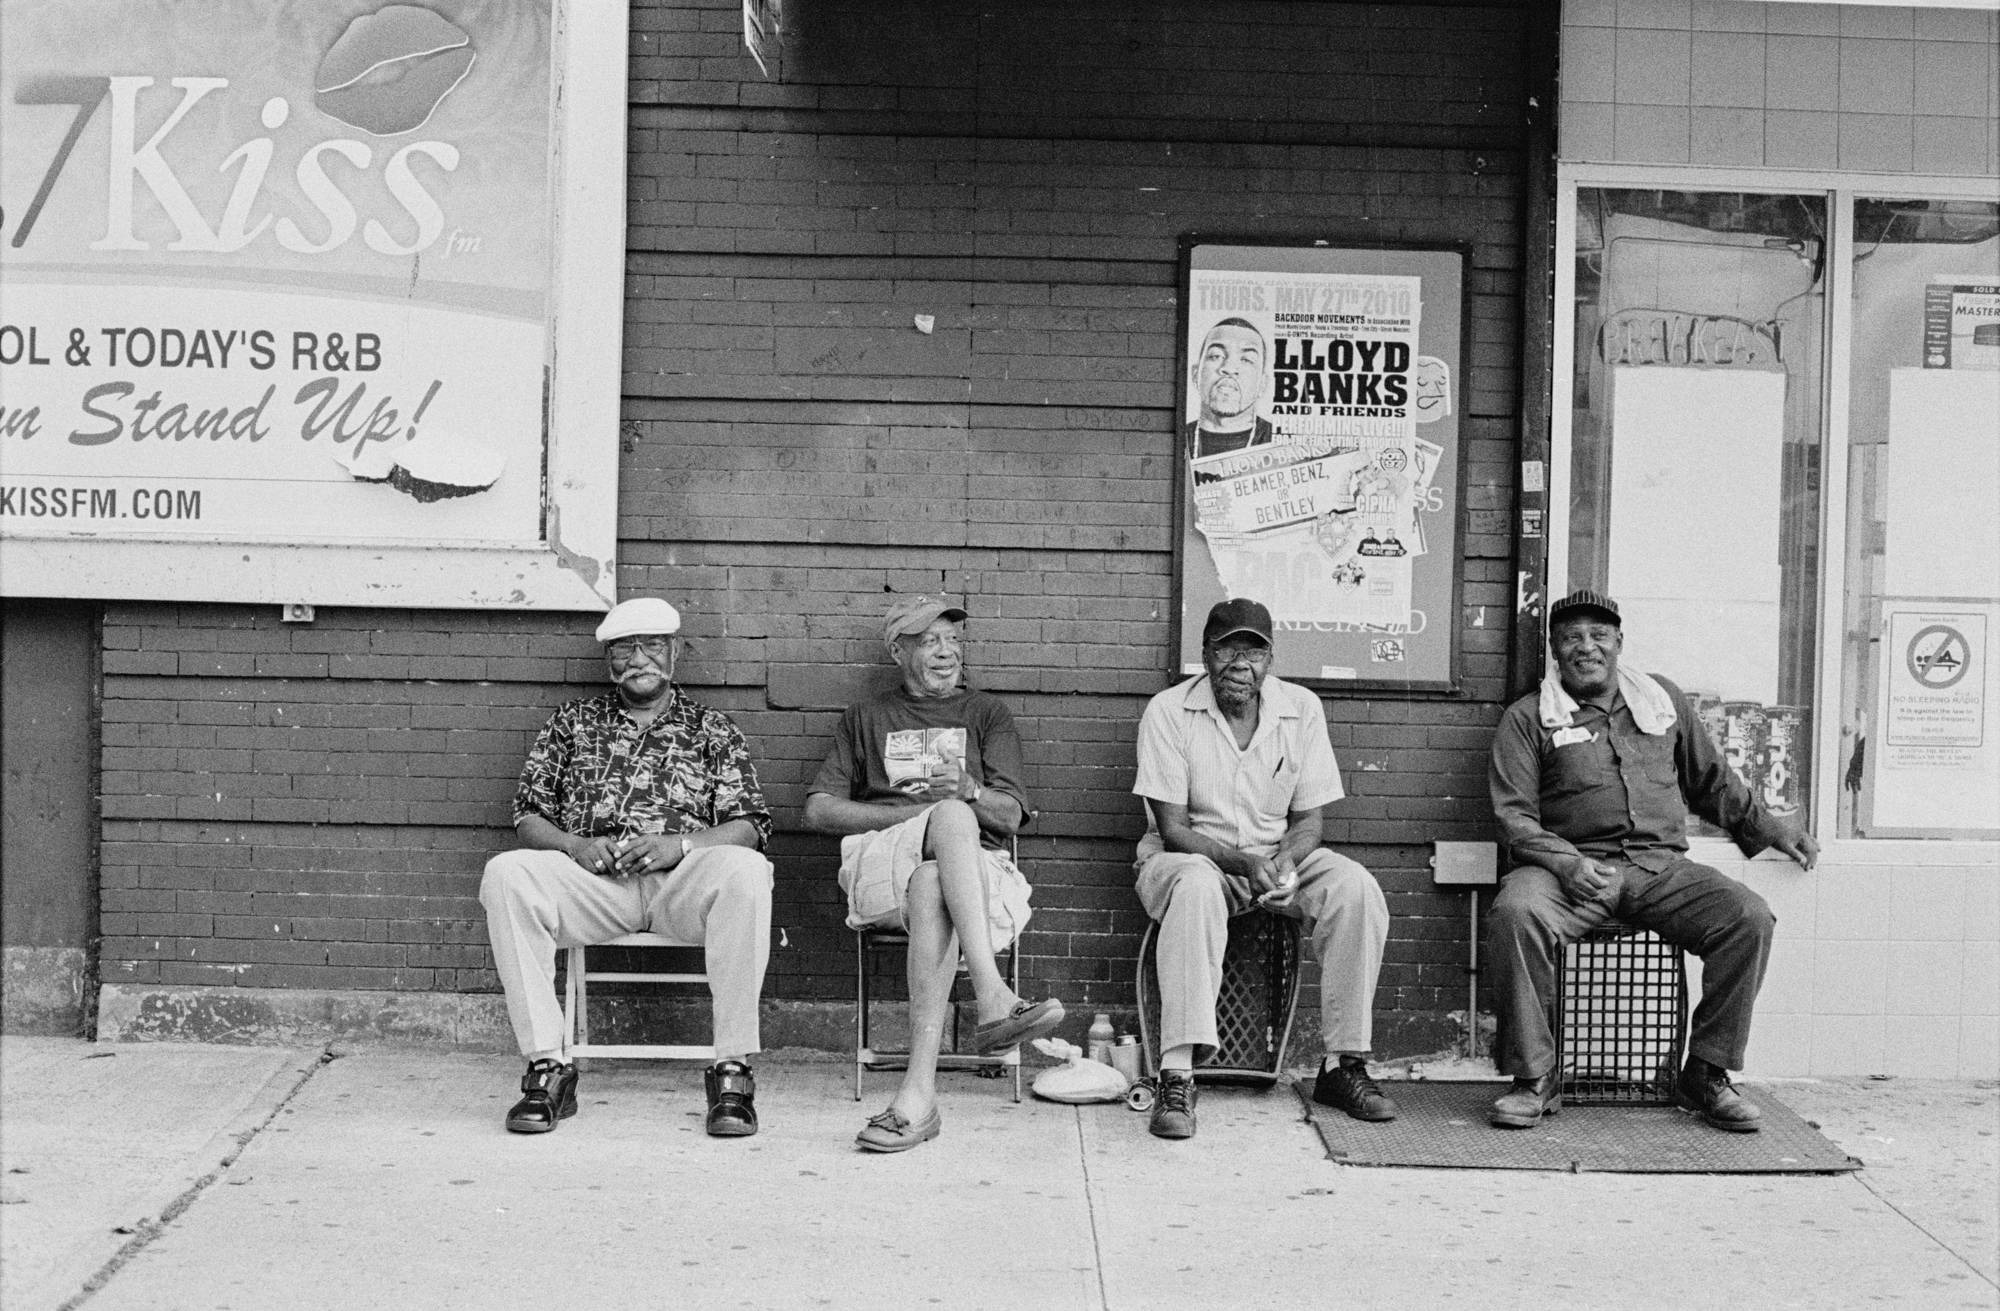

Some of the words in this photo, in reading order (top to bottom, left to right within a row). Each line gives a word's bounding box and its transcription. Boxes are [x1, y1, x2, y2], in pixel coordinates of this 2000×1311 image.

[90, 76, 460, 255] Kiss
[444, 227, 482, 258] fm
[1198, 284, 1269, 312] THURS.
[1275, 287, 1315, 312] MAY
[1320, 288, 1358, 313] 27TH
[1361, 290, 1411, 315] 2010
[1972, 286, 1993, 294] SOLD
[1274, 312, 1316, 323] BACKDOOR
[1317, 314, 1366, 324] MOVEMENTS
[0, 326, 50, 366] OL
[65, 329, 92, 367] &
[102, 328, 277, 371] TODAY'S
[292, 332, 382, 372] R&B
[1273, 338, 1411, 374] LLOYD
[1272, 371, 1409, 407] BANKS
[0, 405, 42, 440] n
[67, 381, 277, 446] Stand
[294, 376, 443, 460] Up!
[1271, 404, 1313, 416] AND
[1319, 405, 1407, 418] FRIENDS
[1233, 470, 1291, 498] BEAMER,
[1290, 462, 1331, 486] BENZ,
[1276, 488, 1290, 501] OR
[0, 486, 202, 520] KISSFM.COM
[1255, 495, 1316, 525] BENTLEY
[1356, 494, 1397, 513] CIPHA
[1893, 696, 1907, 704] NO
[1908, 696, 1951, 704] SLEEPING
[1952, 697, 1980, 705] RADIO
